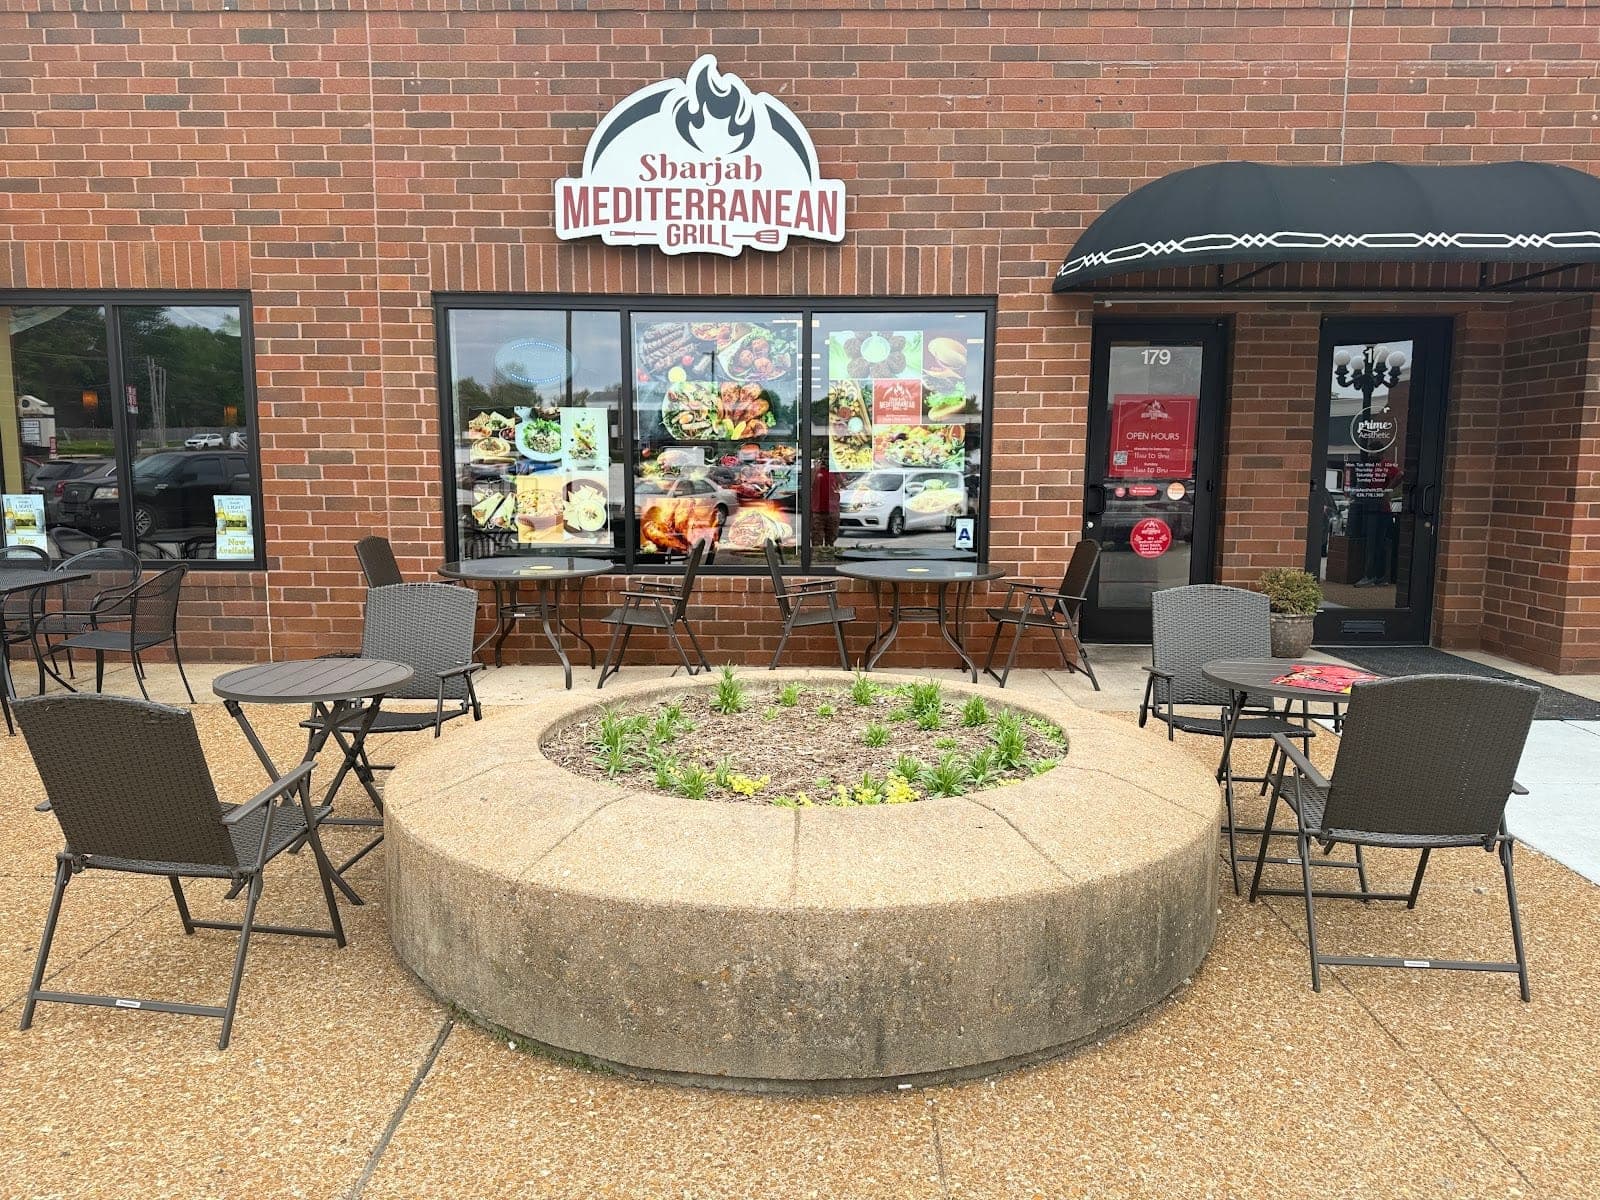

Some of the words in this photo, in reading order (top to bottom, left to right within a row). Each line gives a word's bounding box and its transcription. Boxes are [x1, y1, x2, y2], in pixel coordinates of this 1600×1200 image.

[639, 154, 762, 186] Sharjah
[562, 185, 838, 236] MEDITERRANEAN
[666, 224, 734, 248] GRILL
[1141, 349, 1171, 365] 179
[1357, 419, 1393, 433] prime
[1126, 432, 1149, 440] OPEN
[1150, 432, 1180, 440] HOURS
[1358, 431, 1391, 439] Aesthetic
[958, 528, 971, 541] A
[228, 538, 247, 546] Now
